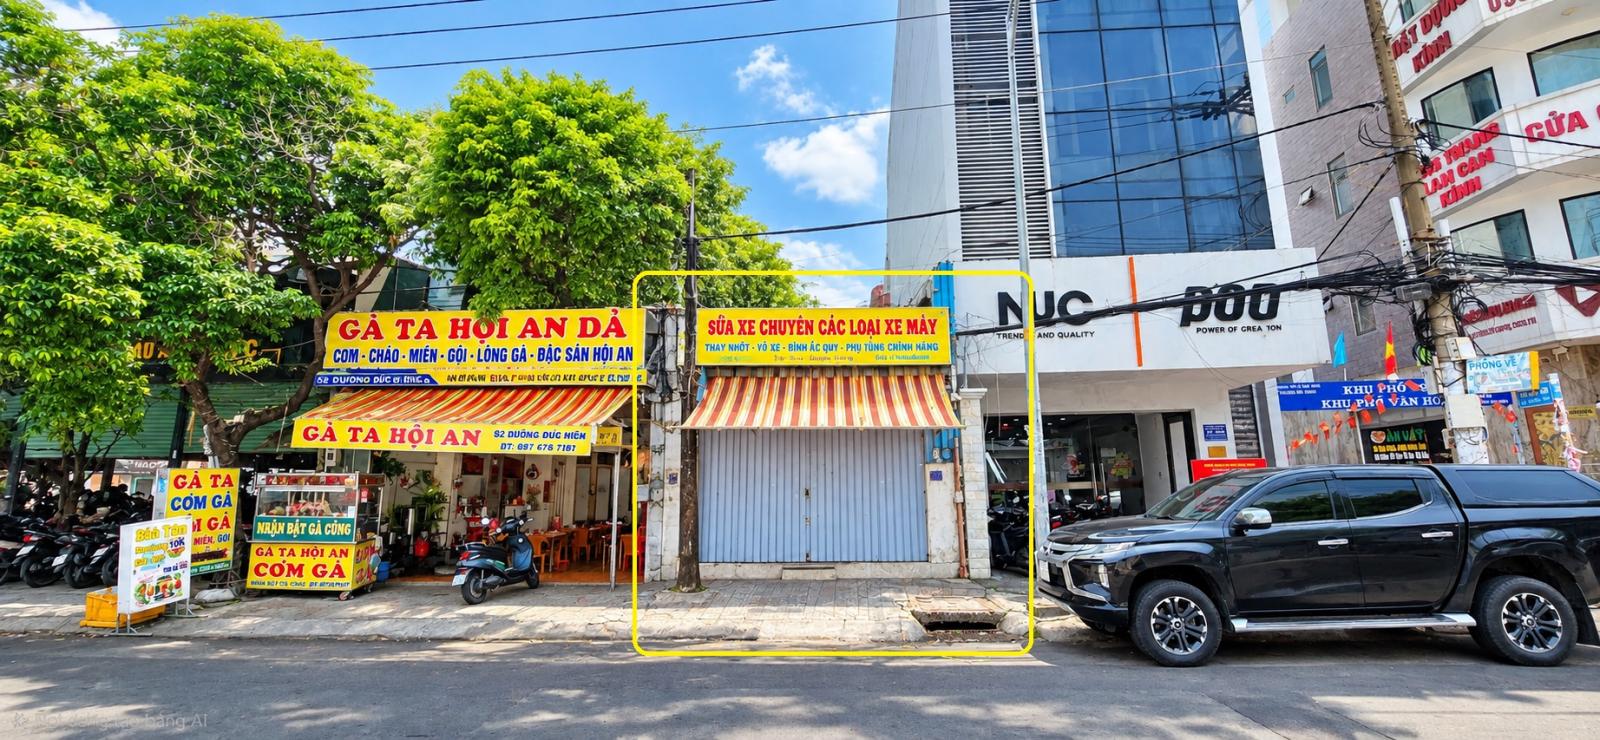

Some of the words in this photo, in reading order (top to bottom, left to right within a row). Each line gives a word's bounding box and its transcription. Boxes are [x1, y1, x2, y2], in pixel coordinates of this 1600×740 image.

[1524, 110, 1589, 143] CỬA
[395, 318, 439, 340] TA
[517, 316, 569, 339] AN
[737, 319, 756, 336] XE
[759, 314, 815, 336] CHUYÊN
[849, 318, 881, 340] LOẠI
[884, 318, 903, 336] XE
[1037, 331, 1055, 339] AND
[1057, 330, 1095, 338] QUALITY
[1196, 326, 1226, 335] POWER
[1227, 325, 1238, 334] OF
[616, 346, 634, 361] AN
[704, 343, 726, 352] THAY
[770, 343, 781, 352] XE
[348, 427, 381, 443] TA
[440, 429, 482, 447] AN
[210, 473, 234, 488] TA
[279, 547, 296, 558] TA
[328, 548, 349, 558] AN
